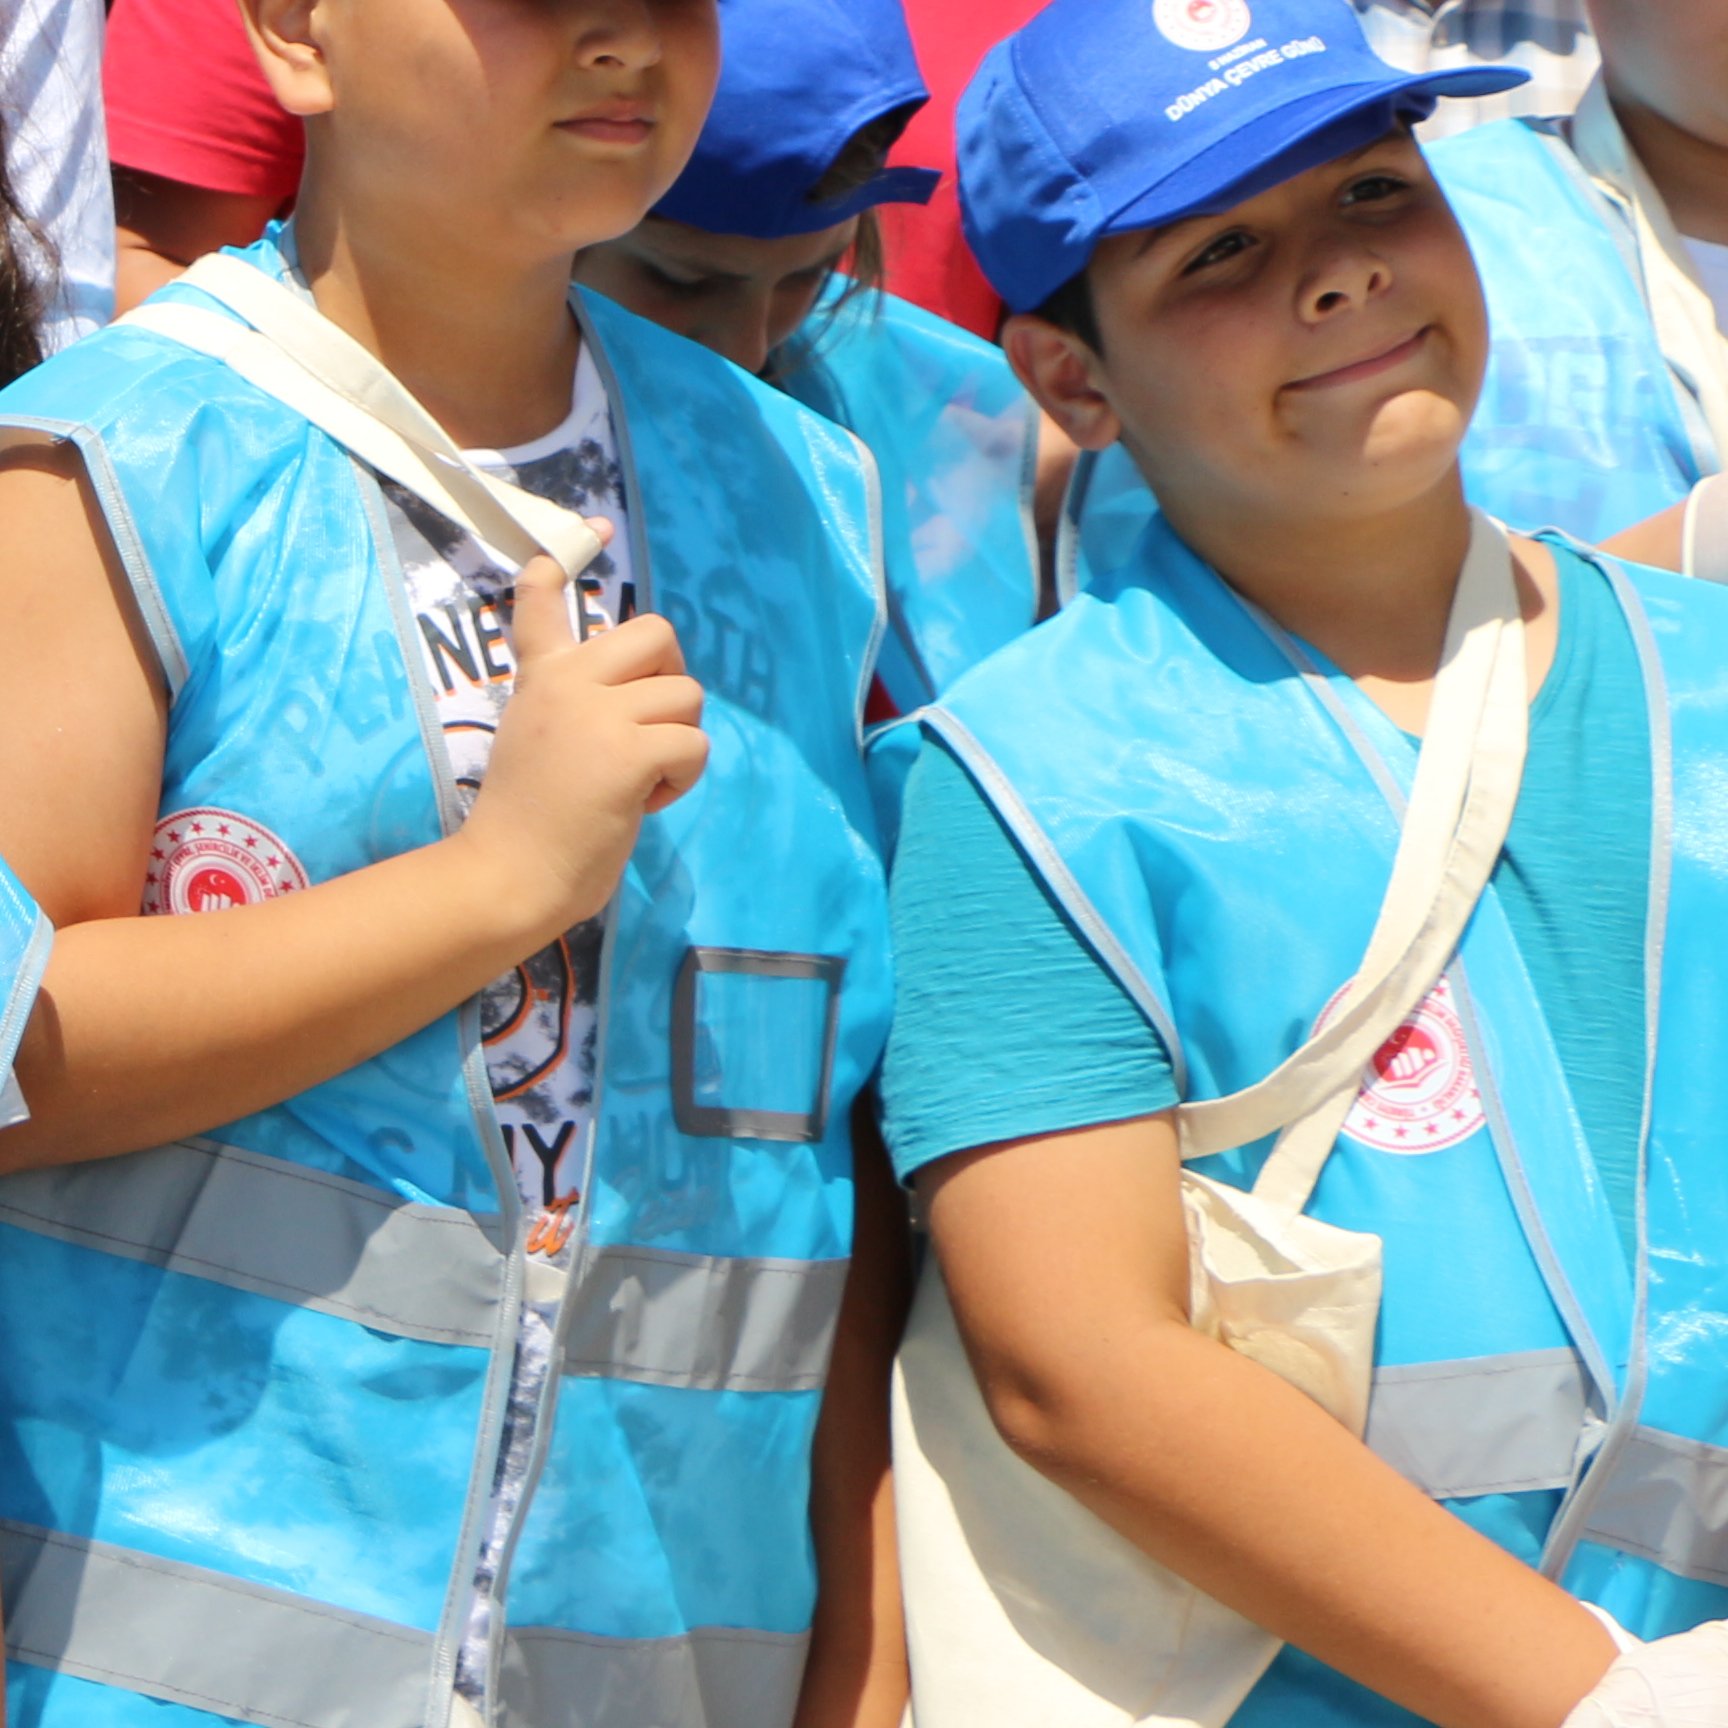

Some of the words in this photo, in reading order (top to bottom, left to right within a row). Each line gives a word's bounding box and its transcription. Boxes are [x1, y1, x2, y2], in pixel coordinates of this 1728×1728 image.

[1164, 77, 1230, 122] DÜNYA
[1223, 48, 1286, 87] ÇEVRE
[1280, 35, 1327, 60] GÜNÜ
